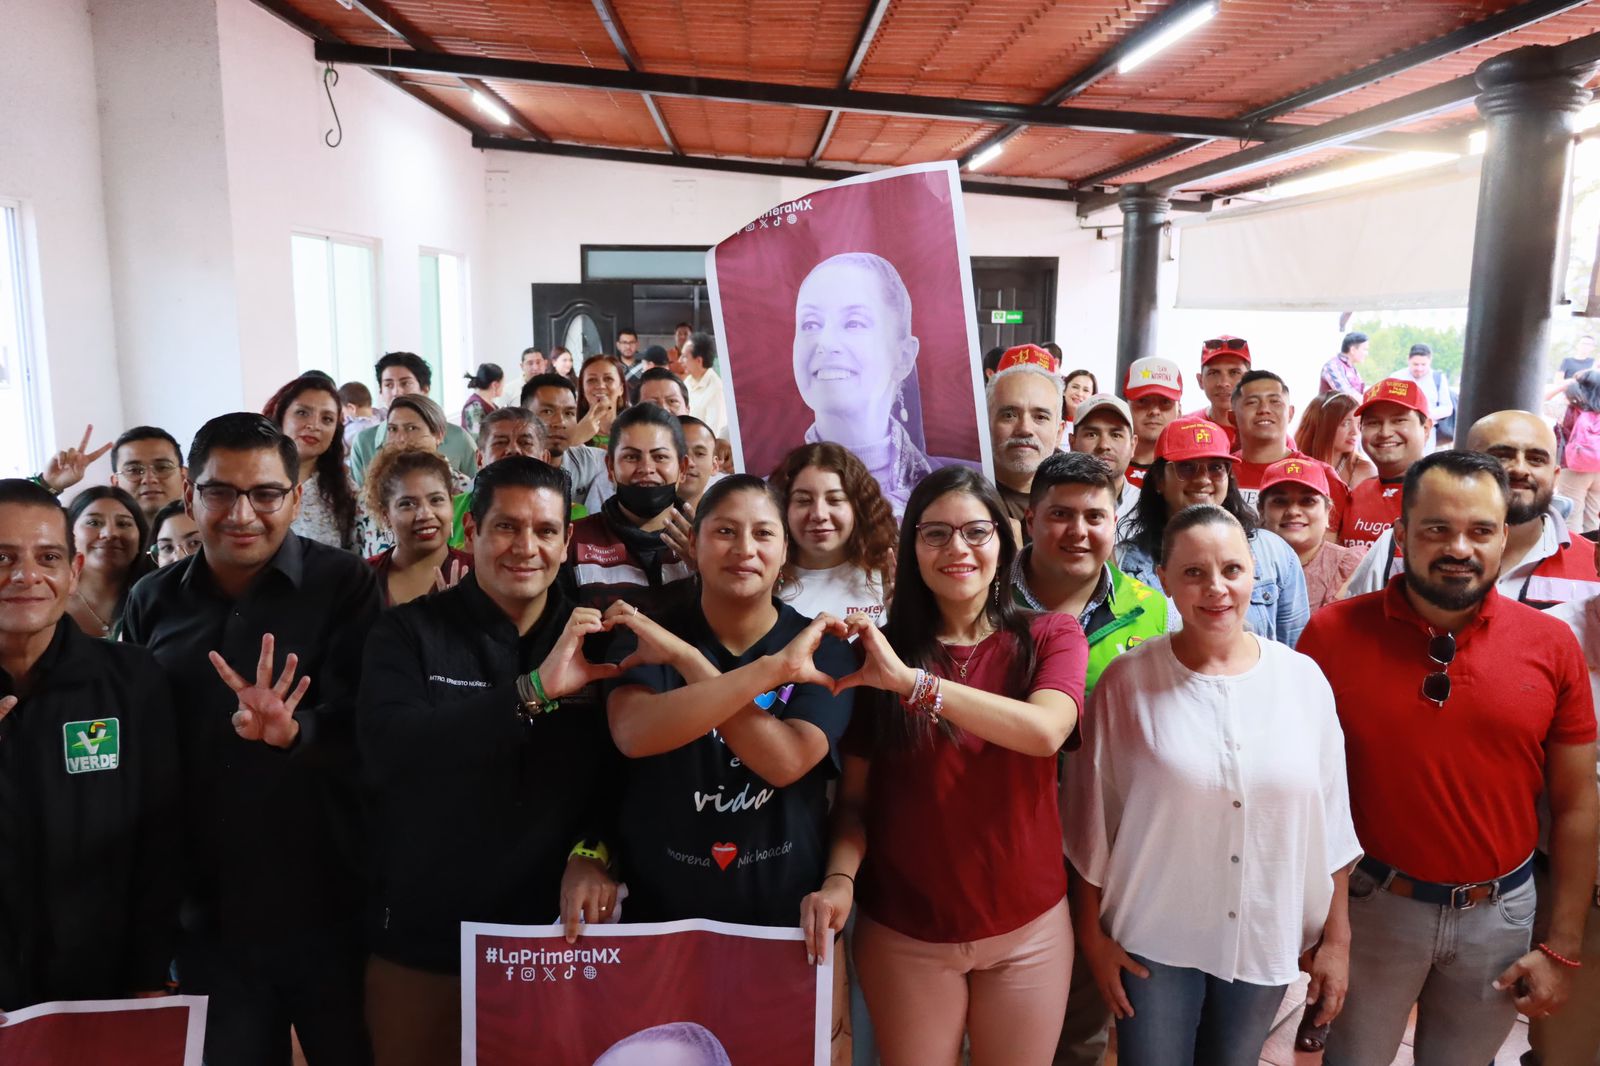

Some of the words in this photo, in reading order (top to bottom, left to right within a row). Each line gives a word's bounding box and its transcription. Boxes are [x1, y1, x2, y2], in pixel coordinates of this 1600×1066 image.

[1354, 518, 1392, 535] hugo
[68, 753, 117, 771] VERDE
[694, 783, 775, 813] vida
[485, 947, 621, 965] #LaPrimeraMX
